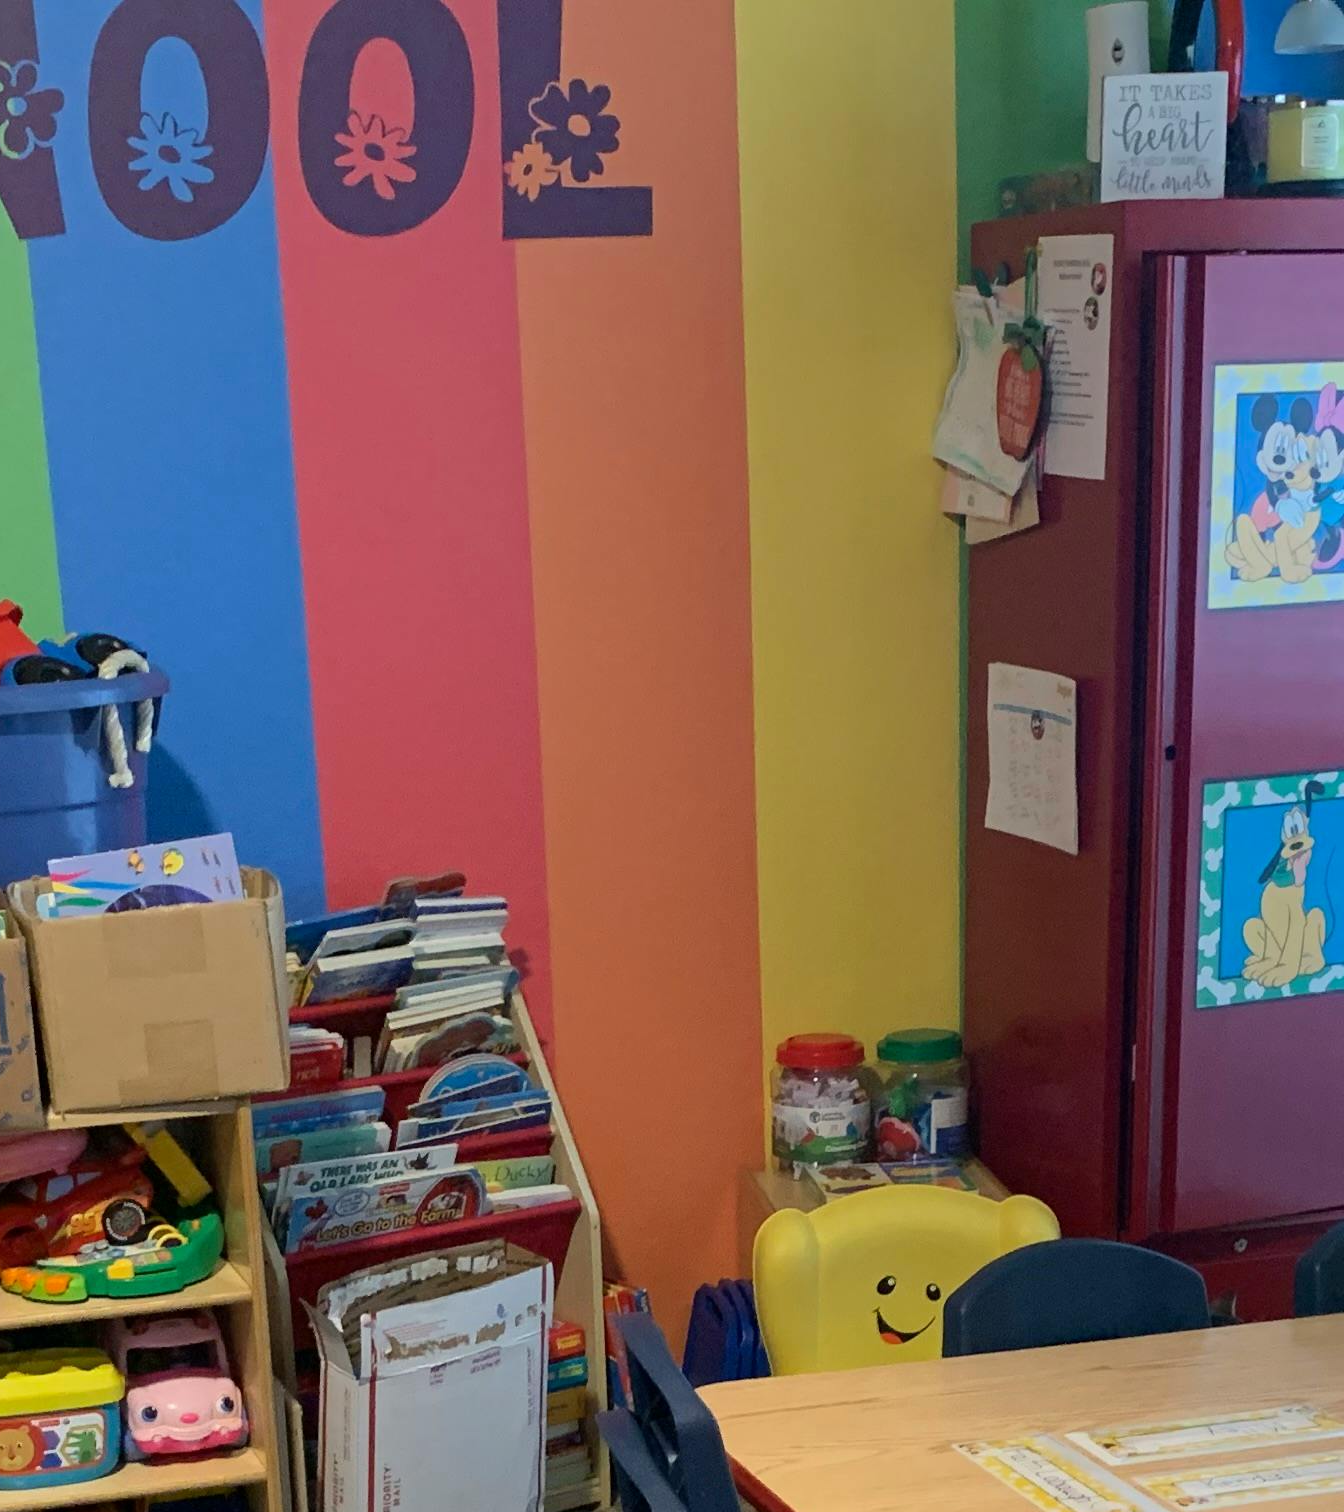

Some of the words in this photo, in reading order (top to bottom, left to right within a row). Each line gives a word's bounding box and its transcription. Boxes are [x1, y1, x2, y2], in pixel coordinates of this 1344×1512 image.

[1118, 84, 1141, 102] IT
[1150, 83, 1212, 101] TAKES
[1112, 103, 1214, 155] heart
[351, 1218, 374, 1235] Go
[375, 1217, 392, 1231] to
[393, 1211, 417, 1228] the
[393, 1478, 401, 1506] MAIL
